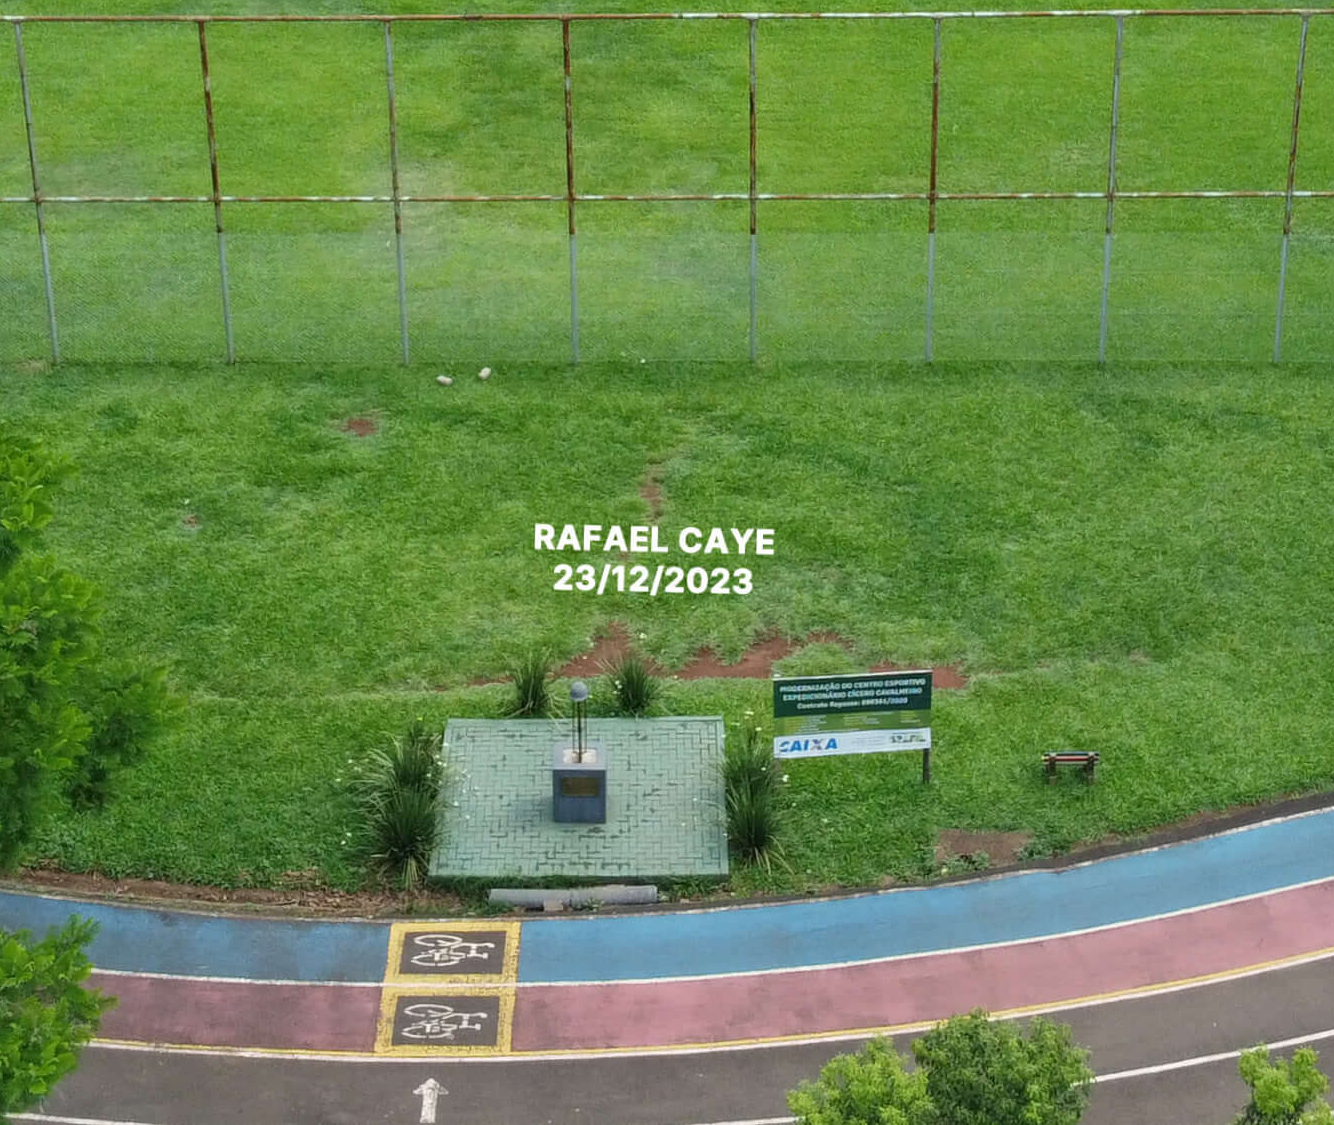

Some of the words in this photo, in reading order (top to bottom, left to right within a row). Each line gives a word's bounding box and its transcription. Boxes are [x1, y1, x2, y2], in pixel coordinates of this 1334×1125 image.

[841, 682, 853, 690] DO
[884, 678, 927, 687] ESPORTIVO
[779, 737, 839, 753] CAIXA
